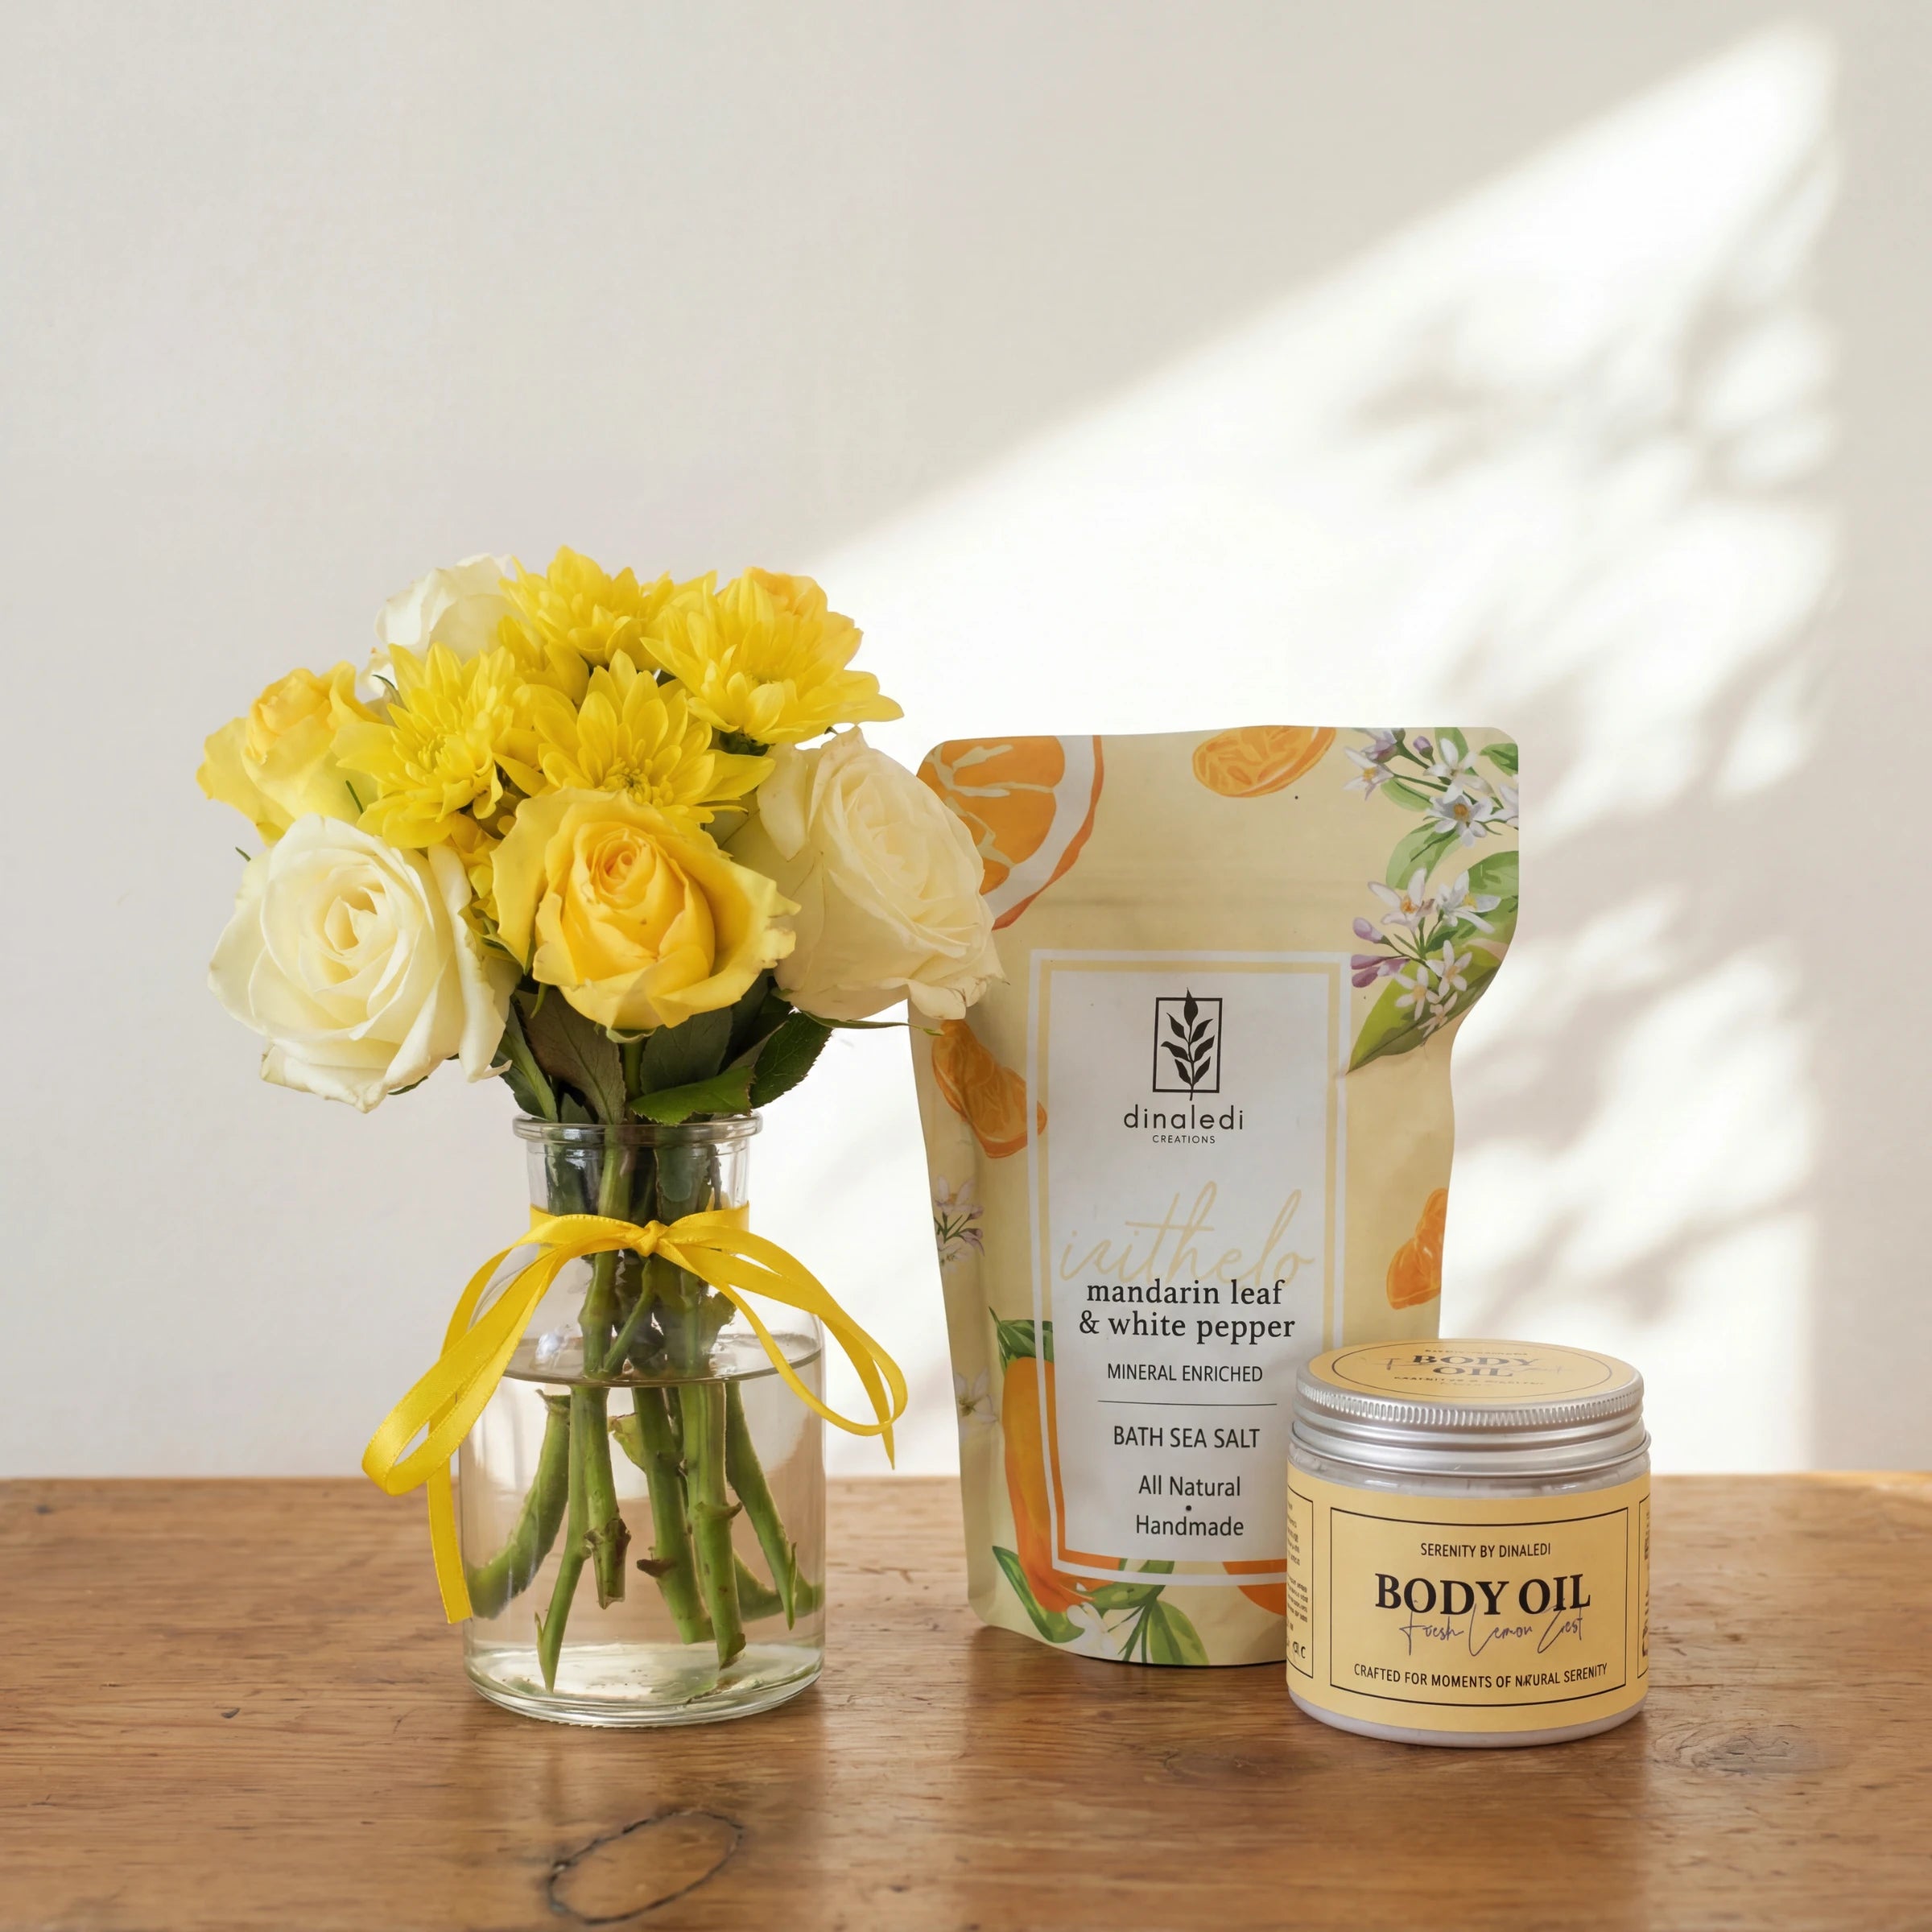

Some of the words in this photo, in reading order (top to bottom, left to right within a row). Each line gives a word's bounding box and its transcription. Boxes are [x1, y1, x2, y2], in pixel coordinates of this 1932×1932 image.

[1124, 1104, 1243, 1129] dinaledi
[1152, 1135, 1216, 1144] CREATIONS
[1087, 1278, 1220, 1303] mandarin
[1230, 1279, 1286, 1304] leaf
[1079, 1310, 1100, 1334] &
[1108, 1311, 1186, 1336] white
[1196, 1319, 1295, 1345] pepper
[1412, 1355, 1538, 1366] BODY
[1107, 1363, 1177, 1381] MINERAL
[1182, 1365, 1263, 1382] ENRICHED
[1432, 1366, 1513, 1377] OIL
[1113, 1426, 1163, 1447] BATH
[1170, 1427, 1208, 1448] SEA
[1213, 1428, 1261, 1449] SALT
[1138, 1475, 1162, 1495] All
[1169, 1476, 1241, 1496] Natural
[1136, 1515, 1244, 1536] Handmade
[1420, 1542, 1476, 1557] SERENITY
[1480, 1545, 1495, 1558] BY
[1499, 1542, 1550, 1557] DINALEDI
[1374, 1573, 1509, 1615] BODY
[1518, 1574, 1591, 1615] OIL
[1354, 1663, 1401, 1682] CRAFTED
[1405, 1671, 1427, 1686] FOR
[1431, 1674, 1492, 1688] MOMENTS
[1496, 1675, 1512, 1687] OF
[1563, 1662, 1608, 1683] SERENITY
